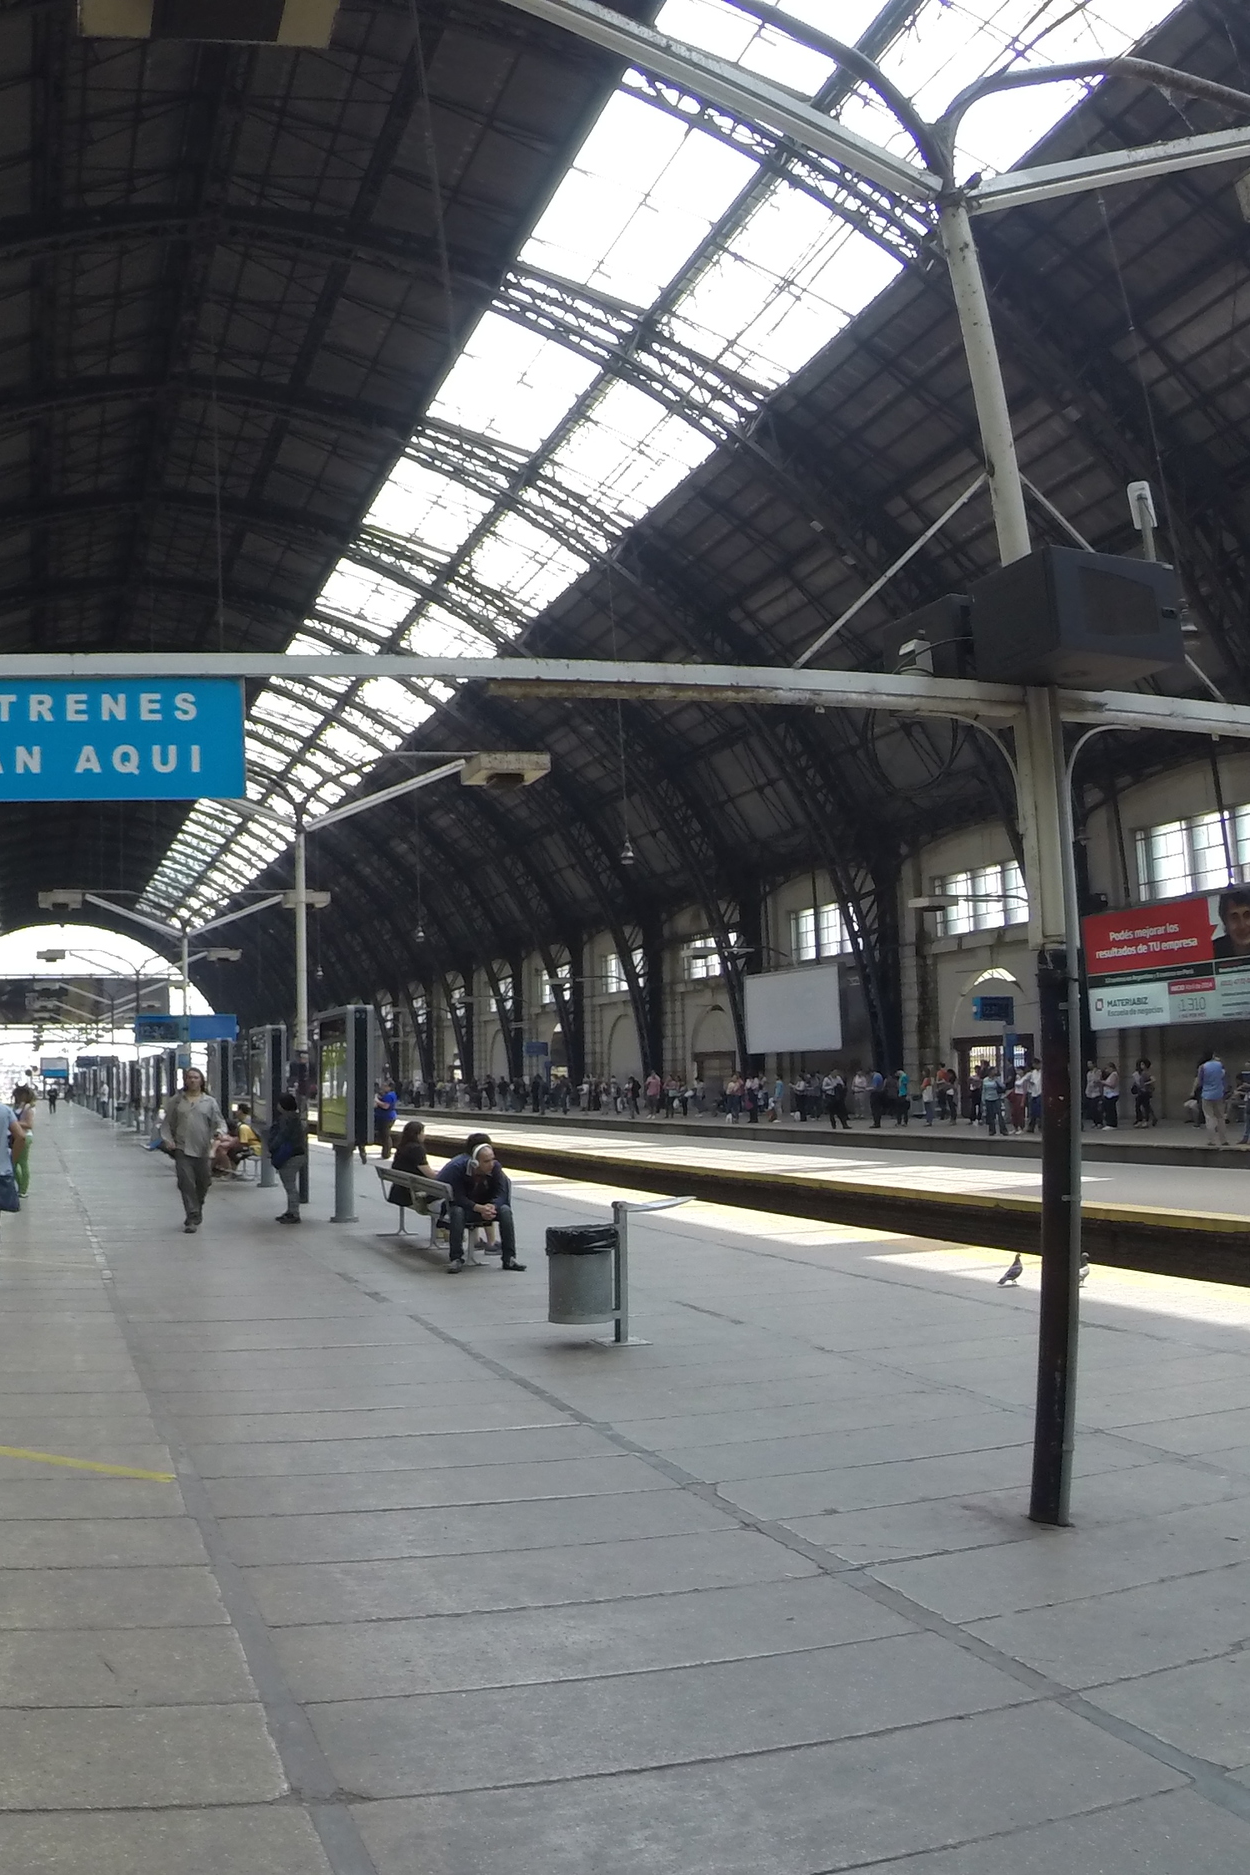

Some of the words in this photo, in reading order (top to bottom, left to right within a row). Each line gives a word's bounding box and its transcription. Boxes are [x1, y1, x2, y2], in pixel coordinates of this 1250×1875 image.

[75, 745, 202, 775] AQUI
[1109, 929, 1134, 941] Podés
[1134, 926, 1166, 938] mejorar
[1166, 923, 1179, 933] los
[1095, 946, 1136, 959] resultados
[1137, 944, 1148, 953] de
[1148, 941, 1160, 952] TU
[1161, 938, 1198, 951] empresa
[1107, 997, 1149, 1007] MATERIABIZ
[1107, 1008, 1129, 1017] Escuela
[1129, 1007, 1137, 1015] de
[1137, 1006, 1164, 1016] negocios
